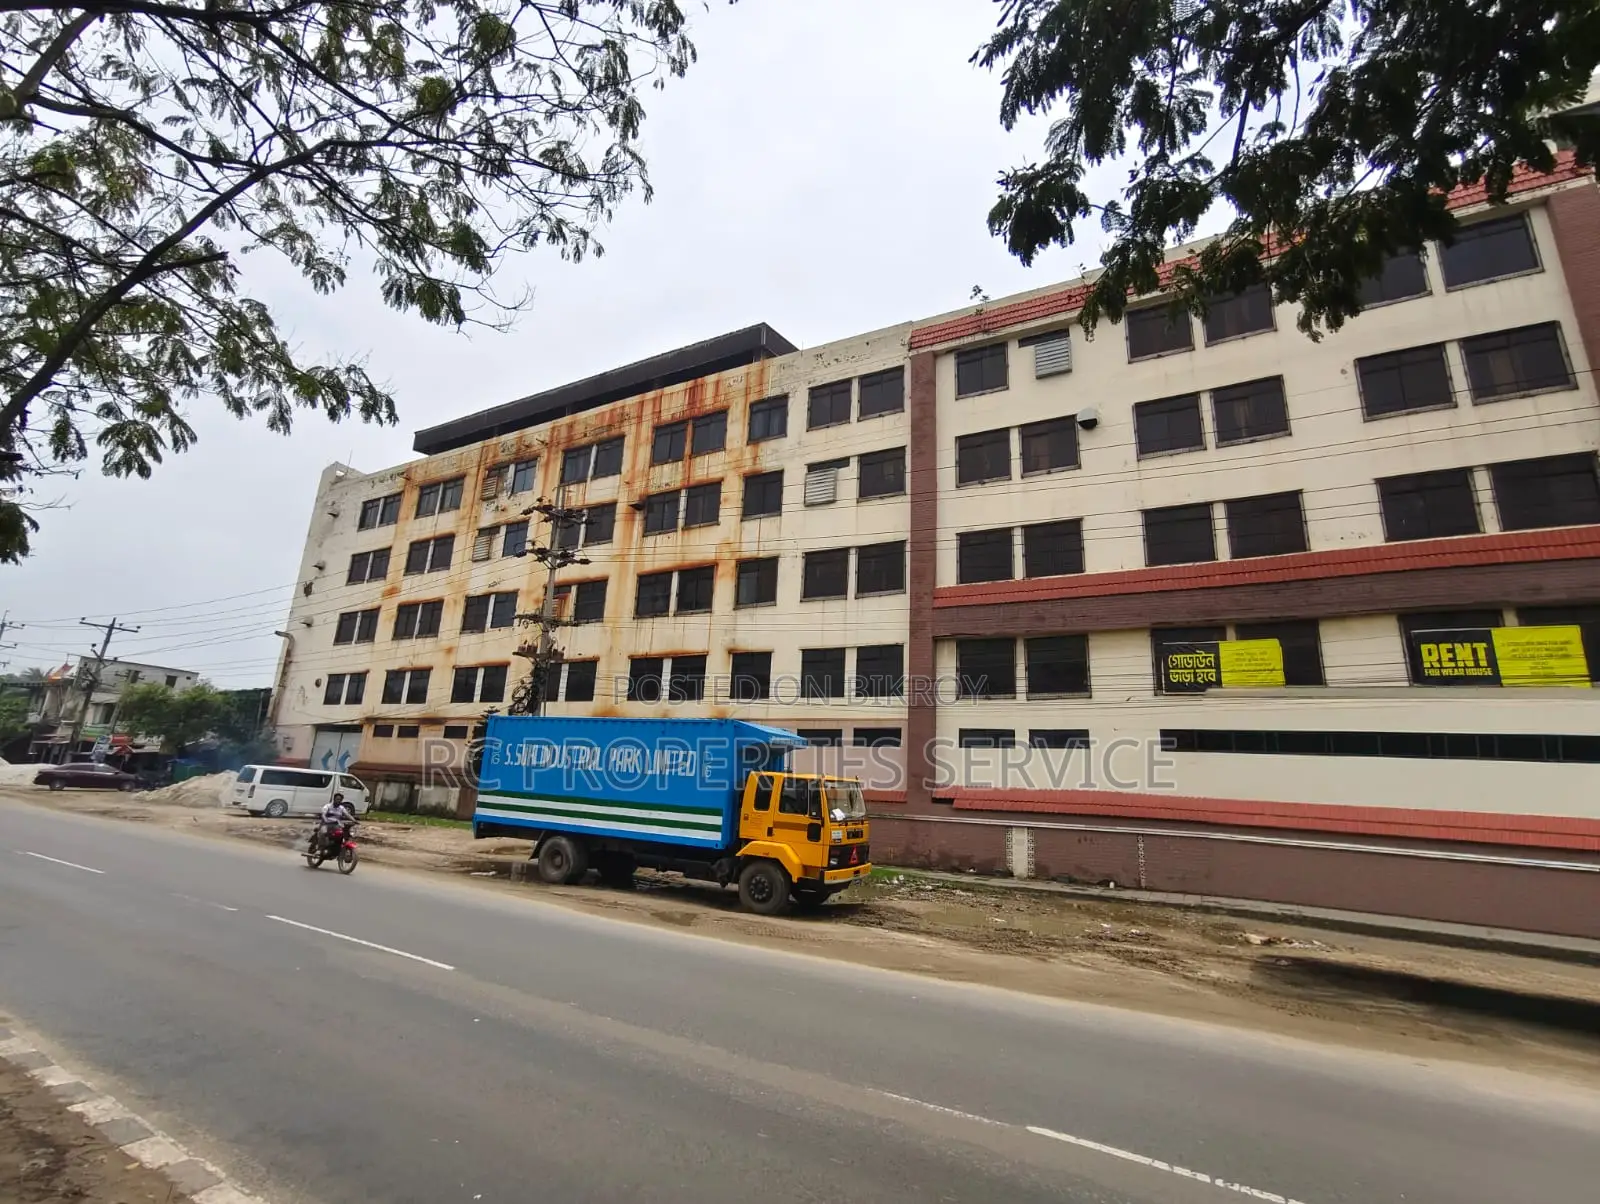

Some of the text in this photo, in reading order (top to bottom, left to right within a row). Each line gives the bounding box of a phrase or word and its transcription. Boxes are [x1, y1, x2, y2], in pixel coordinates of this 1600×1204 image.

[1168, 650, 1215, 668] গোডাউন
[1420, 643, 1488, 668] RENT
[1169, 669, 1216, 687] ভাড়া হবে
[1424, 667, 1494, 677] FOR WEAR HOUSE
[608, 747, 642, 774] PARK
[644, 749, 697, 777] LIMITED
